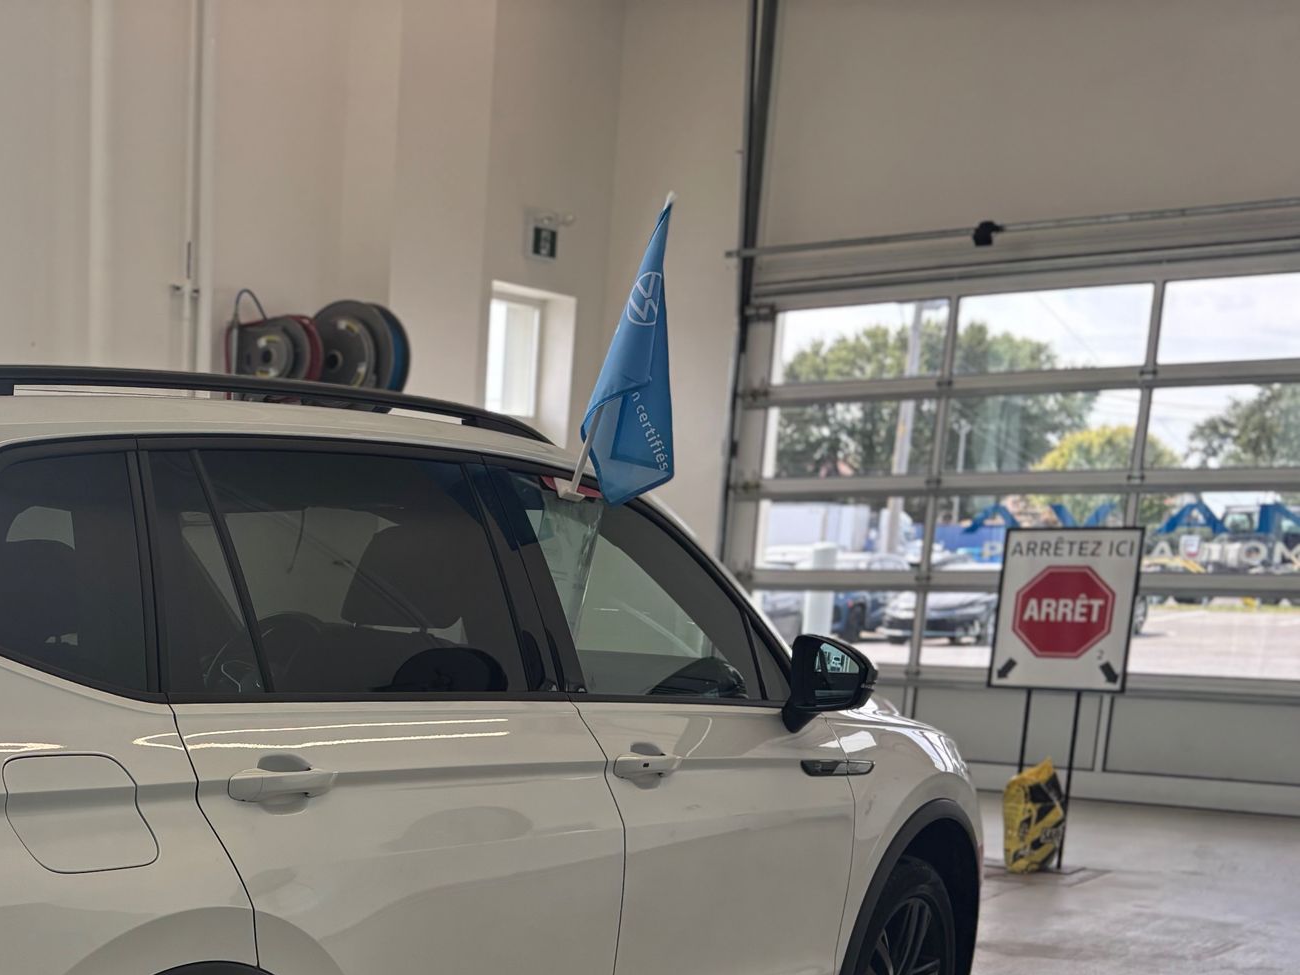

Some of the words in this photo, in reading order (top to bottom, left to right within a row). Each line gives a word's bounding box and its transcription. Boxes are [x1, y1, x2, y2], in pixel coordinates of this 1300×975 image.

[636, 404, 669, 471] certifiés
[1010, 537, 1103, 557] ARRÊTEZ
[1108, 540, 1136, 558] ICI
[1022, 593, 1105, 624] ARRÊT
